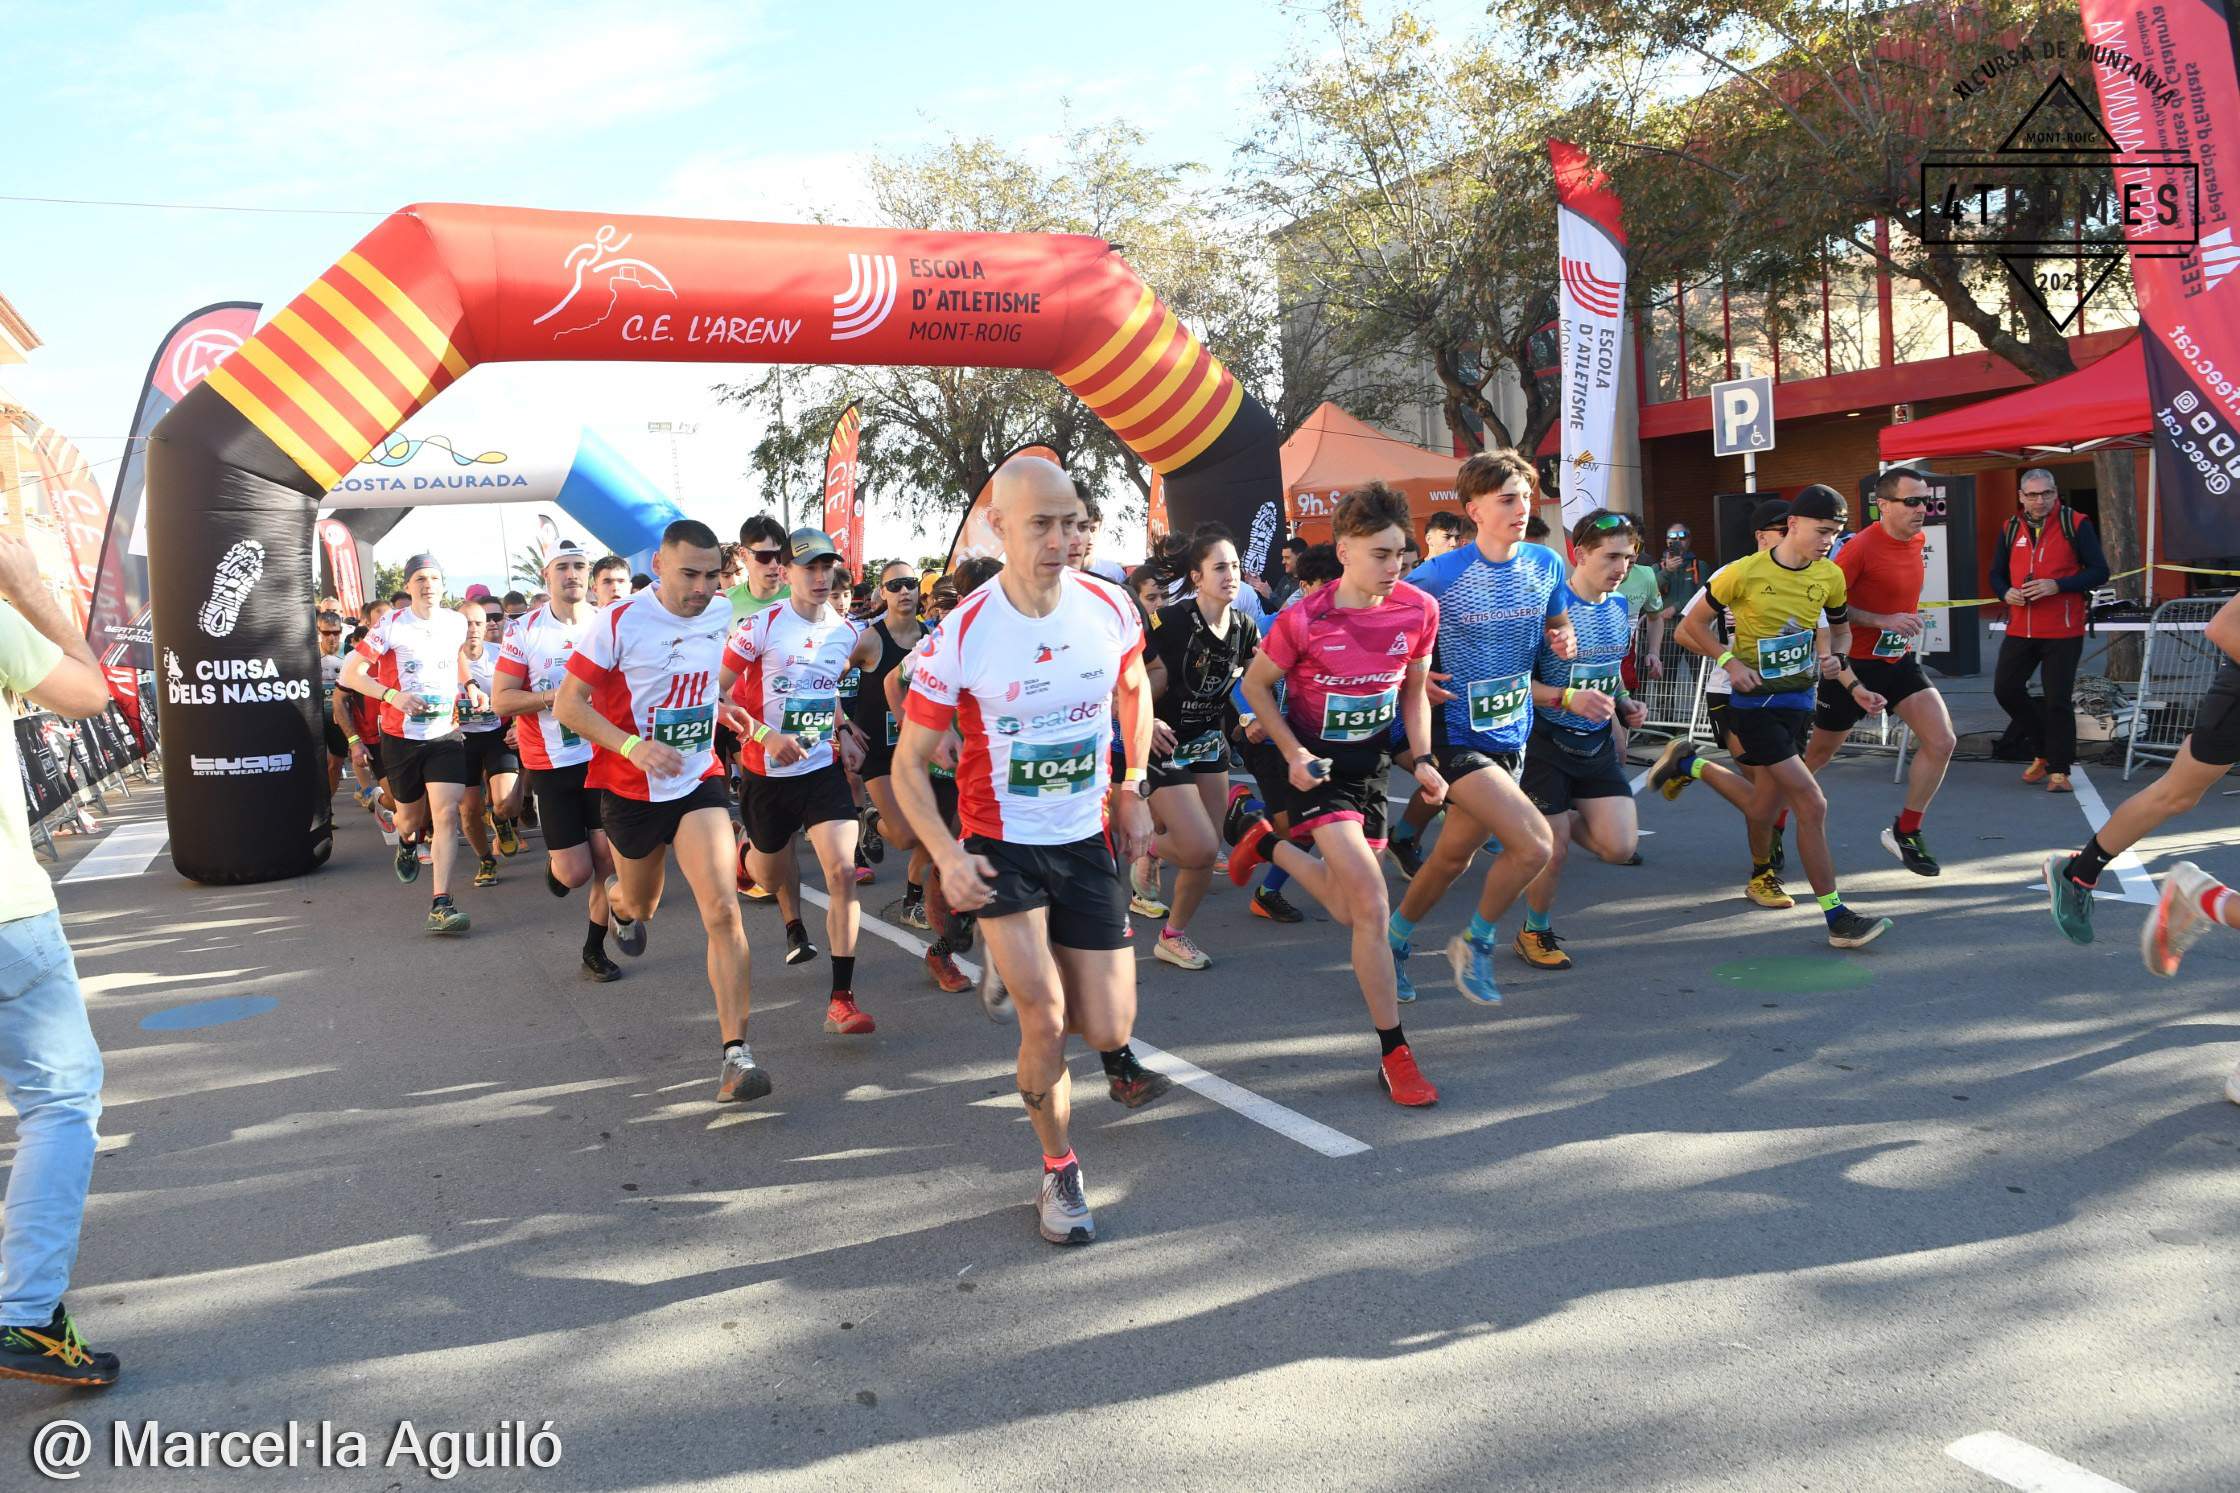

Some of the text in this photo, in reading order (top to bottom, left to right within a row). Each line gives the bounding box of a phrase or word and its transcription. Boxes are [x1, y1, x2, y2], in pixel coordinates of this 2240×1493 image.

[909, 258, 985, 280] ESCOLA
[622, 314, 802, 345] C.E. L'ARENY
[908, 321, 1023, 342] MONT-ROIG
[1596, 328, 1615, 389] ESCOLA
[1723, 387, 1760, 447] P
[331, 474, 528, 493] COSTA DAURADA
[1490, 606, 1546, 620] COLLSEROL
[1767, 645, 1809, 665] 1301
[196, 658, 279, 681] CURSA
[168, 684, 217, 705] DELS
[222, 679, 311, 704] NASSOS
[1479, 688, 1528, 713] 1317
[1335, 704, 1391, 727] 1313
[663, 719, 711, 742] 1221
[1020, 753, 1095, 780] 1044
